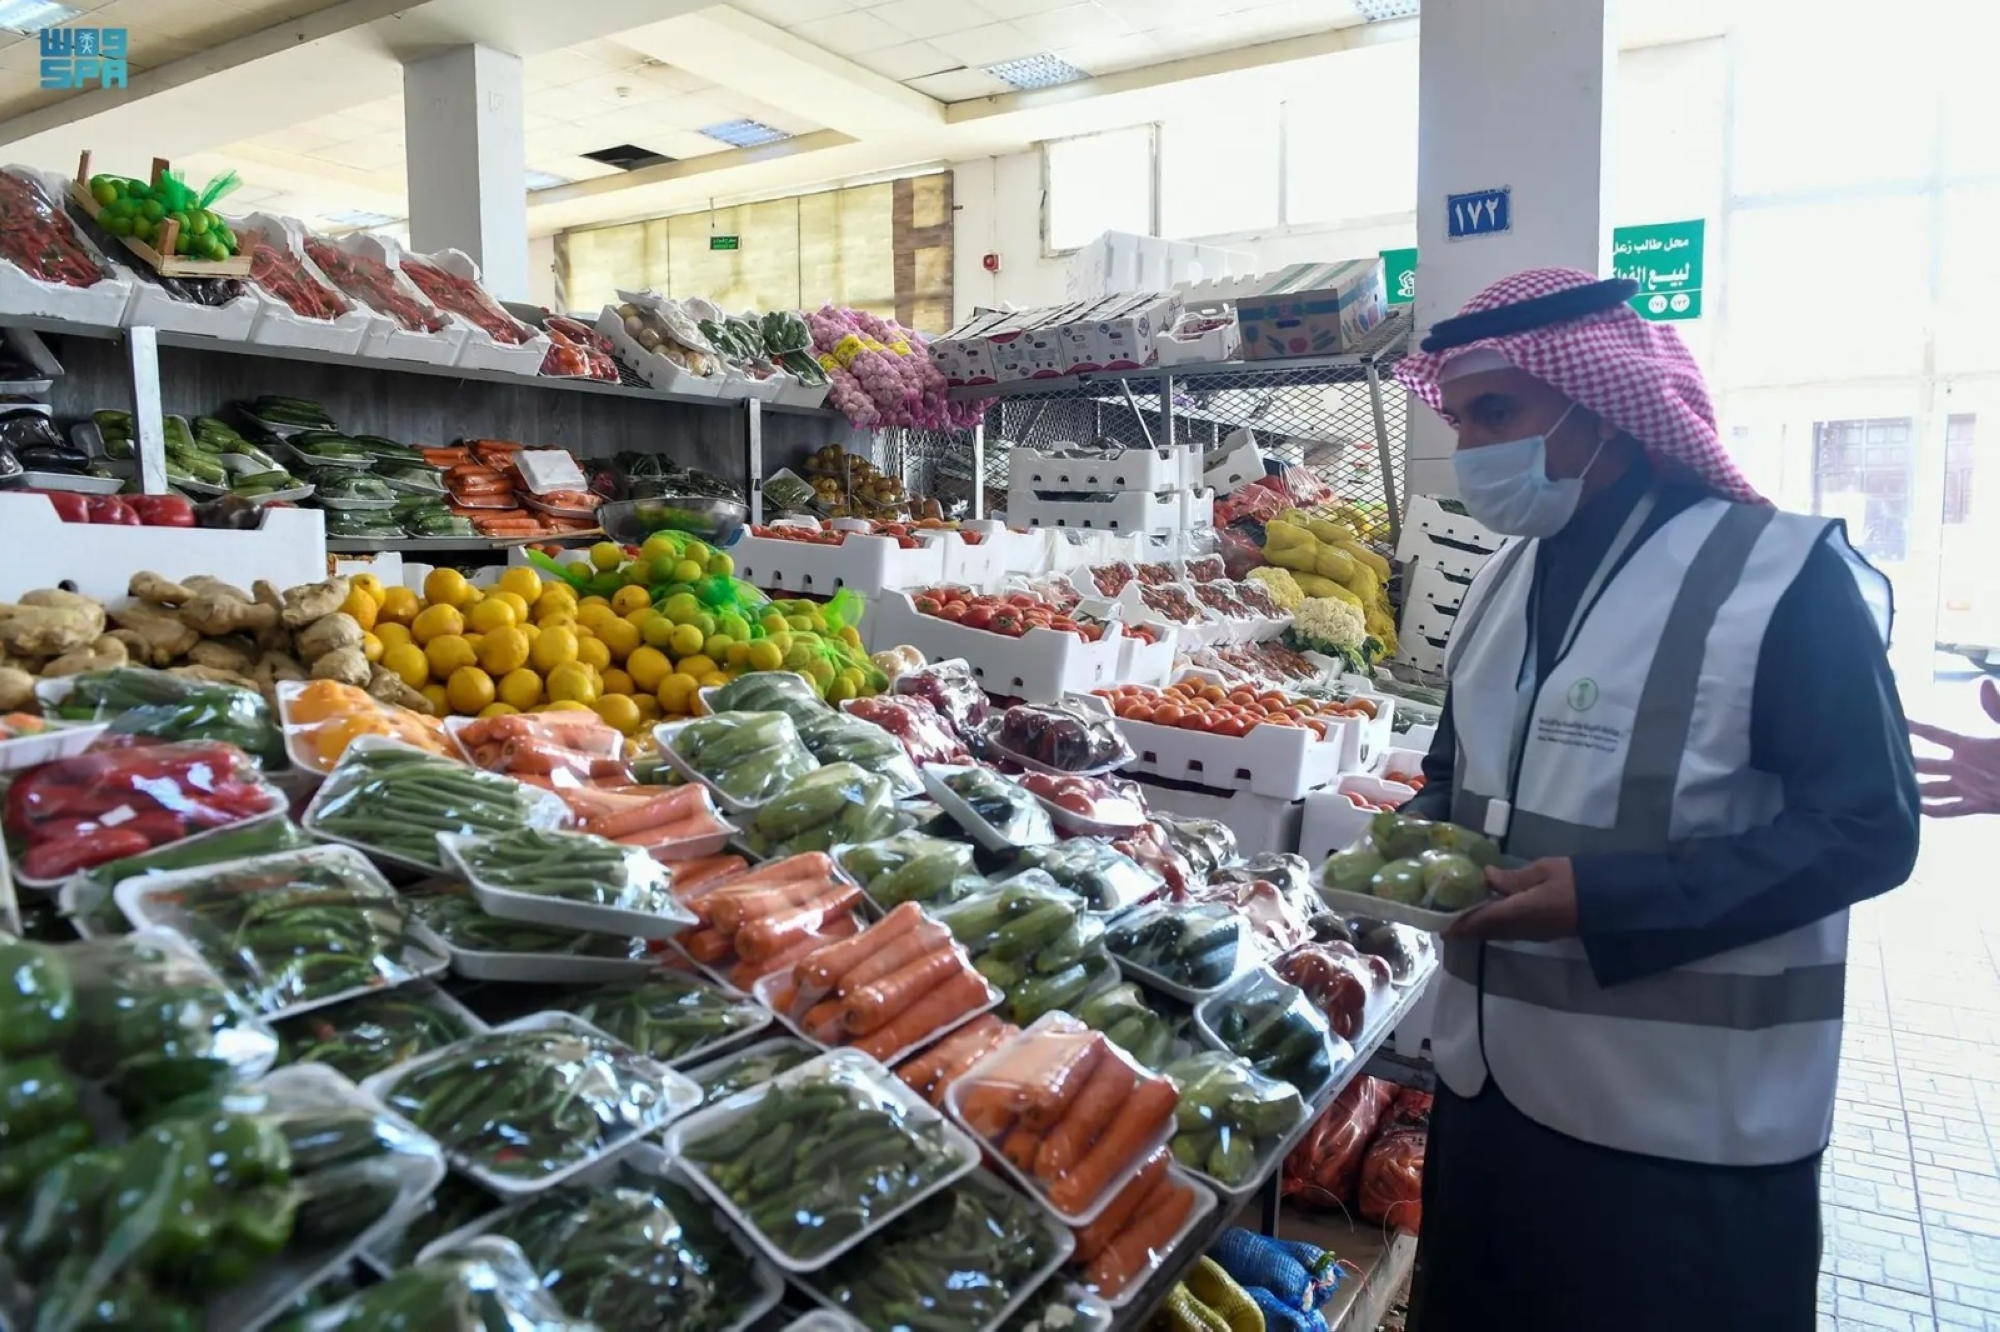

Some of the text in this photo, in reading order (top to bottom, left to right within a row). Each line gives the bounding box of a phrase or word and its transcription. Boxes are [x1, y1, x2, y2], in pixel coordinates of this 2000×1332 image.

[1455, 198, 1499, 232] ١٧٢
[1633, 239, 1662, 254] طالب
[1663, 238, 1689, 251] محل
[1648, 262, 1689, 290] لبيع
